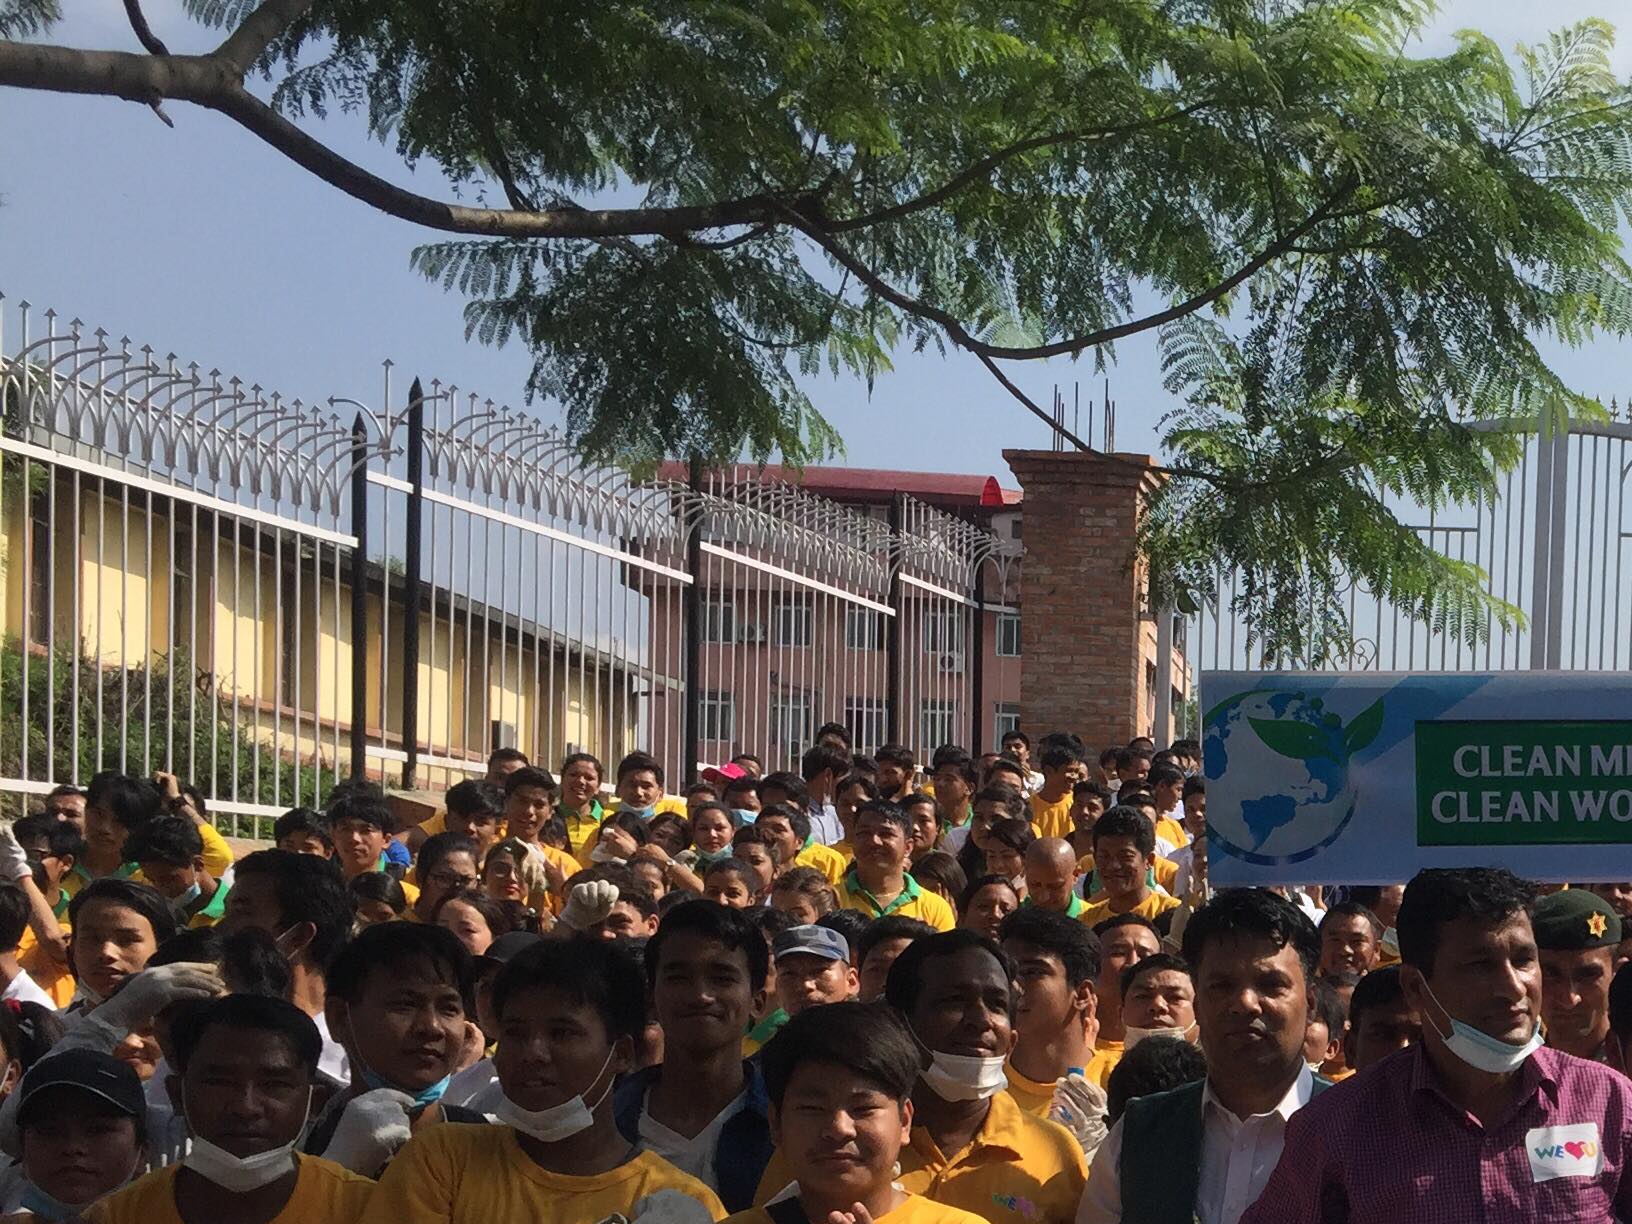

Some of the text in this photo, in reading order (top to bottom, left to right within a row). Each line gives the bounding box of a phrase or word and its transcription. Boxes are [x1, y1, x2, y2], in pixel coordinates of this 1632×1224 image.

[1453, 745, 1581, 777] CLEAN
[1432, 791, 1558, 823] CLEAN
[1534, 1142, 1597, 1160] WE U
